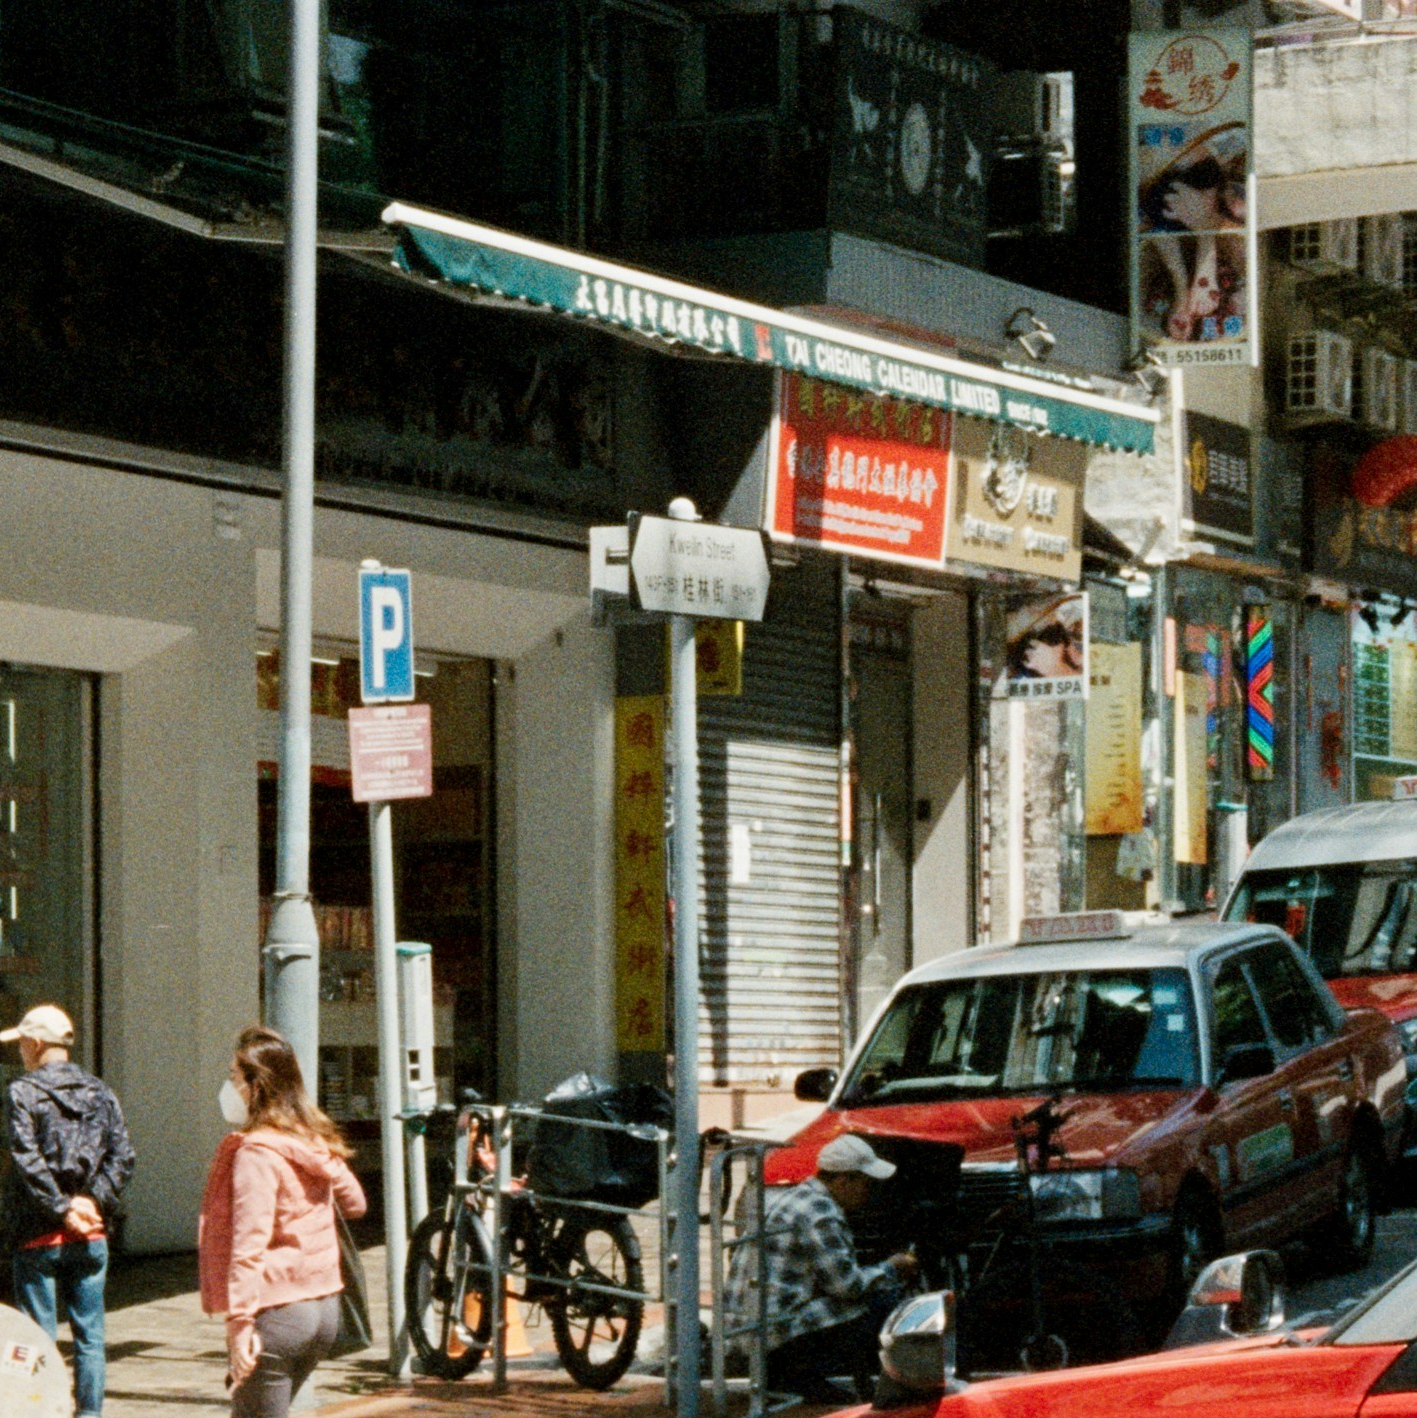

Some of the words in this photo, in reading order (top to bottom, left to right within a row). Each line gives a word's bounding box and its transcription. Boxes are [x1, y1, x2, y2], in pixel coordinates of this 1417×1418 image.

[785, 335, 810, 367] TAI
[814, 341, 872, 384] CHEONG
[876, 359, 946, 398] CALENDAR
[950, 379, 1001, 415] LIMITED
[370, 585, 404, 688] P
